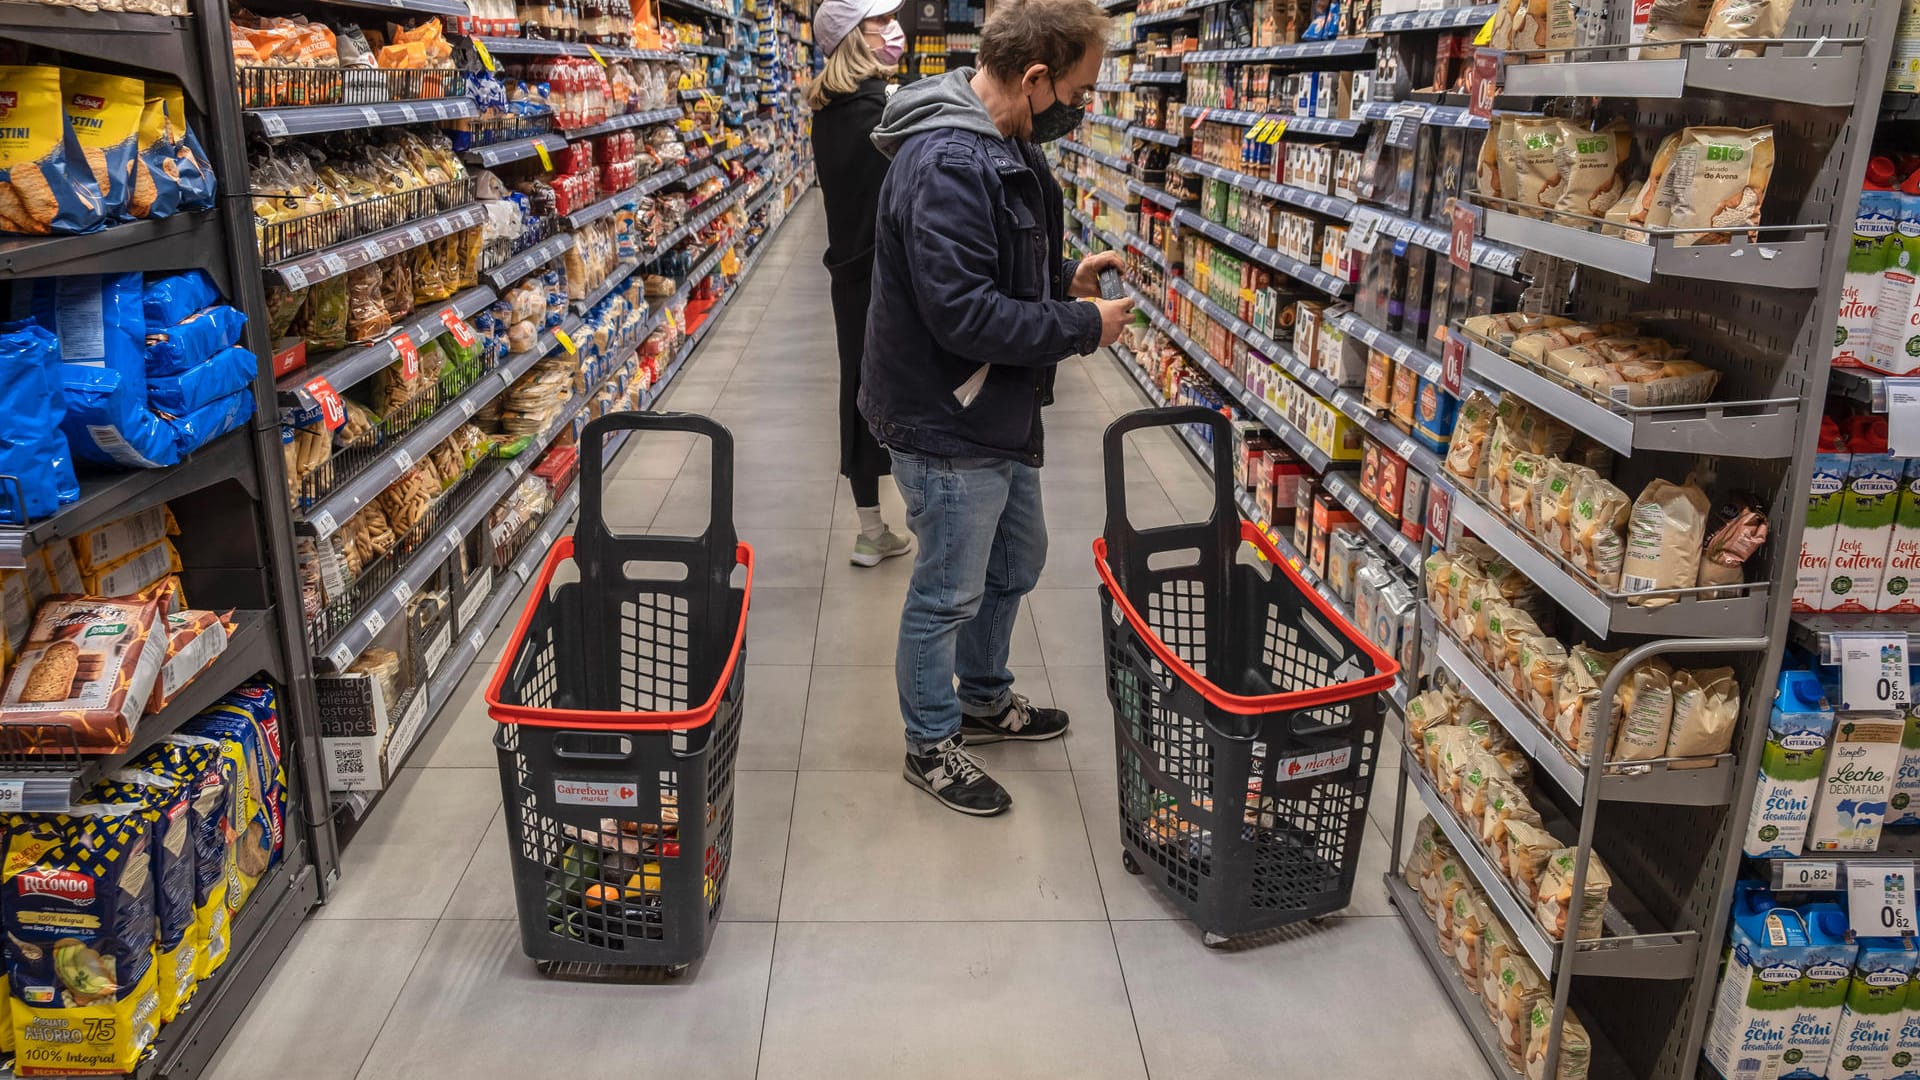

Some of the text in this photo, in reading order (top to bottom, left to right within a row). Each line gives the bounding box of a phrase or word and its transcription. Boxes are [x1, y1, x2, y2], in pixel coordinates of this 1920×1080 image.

[1707, 146, 1744, 161] BIO
[1704, 165, 1729, 173] Salvado
[1714, 172, 1739, 180] Avena
[1853, 481, 1894, 492] ASTURIANA
[1838, 538, 1863, 553] Leche
[1895, 539, 1919, 553] Leche
[1834, 550, 1884, 570] entera
[1783, 738, 1823, 748] ASTURIANA
[1305, 752, 1348, 771] market
[1828, 762, 1885, 784] Leche
[557, 784, 609, 797] Carrefour
[1769, 785, 1793, 798] Leche
[1829, 784, 1885, 796] DESNATADA
[580, 795, 609, 803] market
[1765, 796, 1808, 812] semi
[1762, 810, 1808, 822] desnatada
[23, 876, 89, 895] RECONDO
[1760, 970, 1799, 980] ASTURIANA
[1808, 967, 1847, 978] ASTURIANA
[1867, 974, 1906, 985] ASTURIANA
[1749, 1017, 1772, 1030] Leche
[1795, 1012, 1818, 1025] Leche
[82, 1017, 117, 1042] 75
[1790, 1021, 1832, 1038] semi
[1854, 1020, 1877, 1032] Leche
[24, 1026, 84, 1044] AHORRO
[1744, 1025, 1785, 1044] semi
[1787, 1035, 1831, 1046] desnatada
[1850, 1027, 1892, 1045] semi
[1741, 1042, 1784, 1052] desnatada
[1846, 1043, 1890, 1052] desnatada
[25, 1049, 116, 1067] 100% Integral
